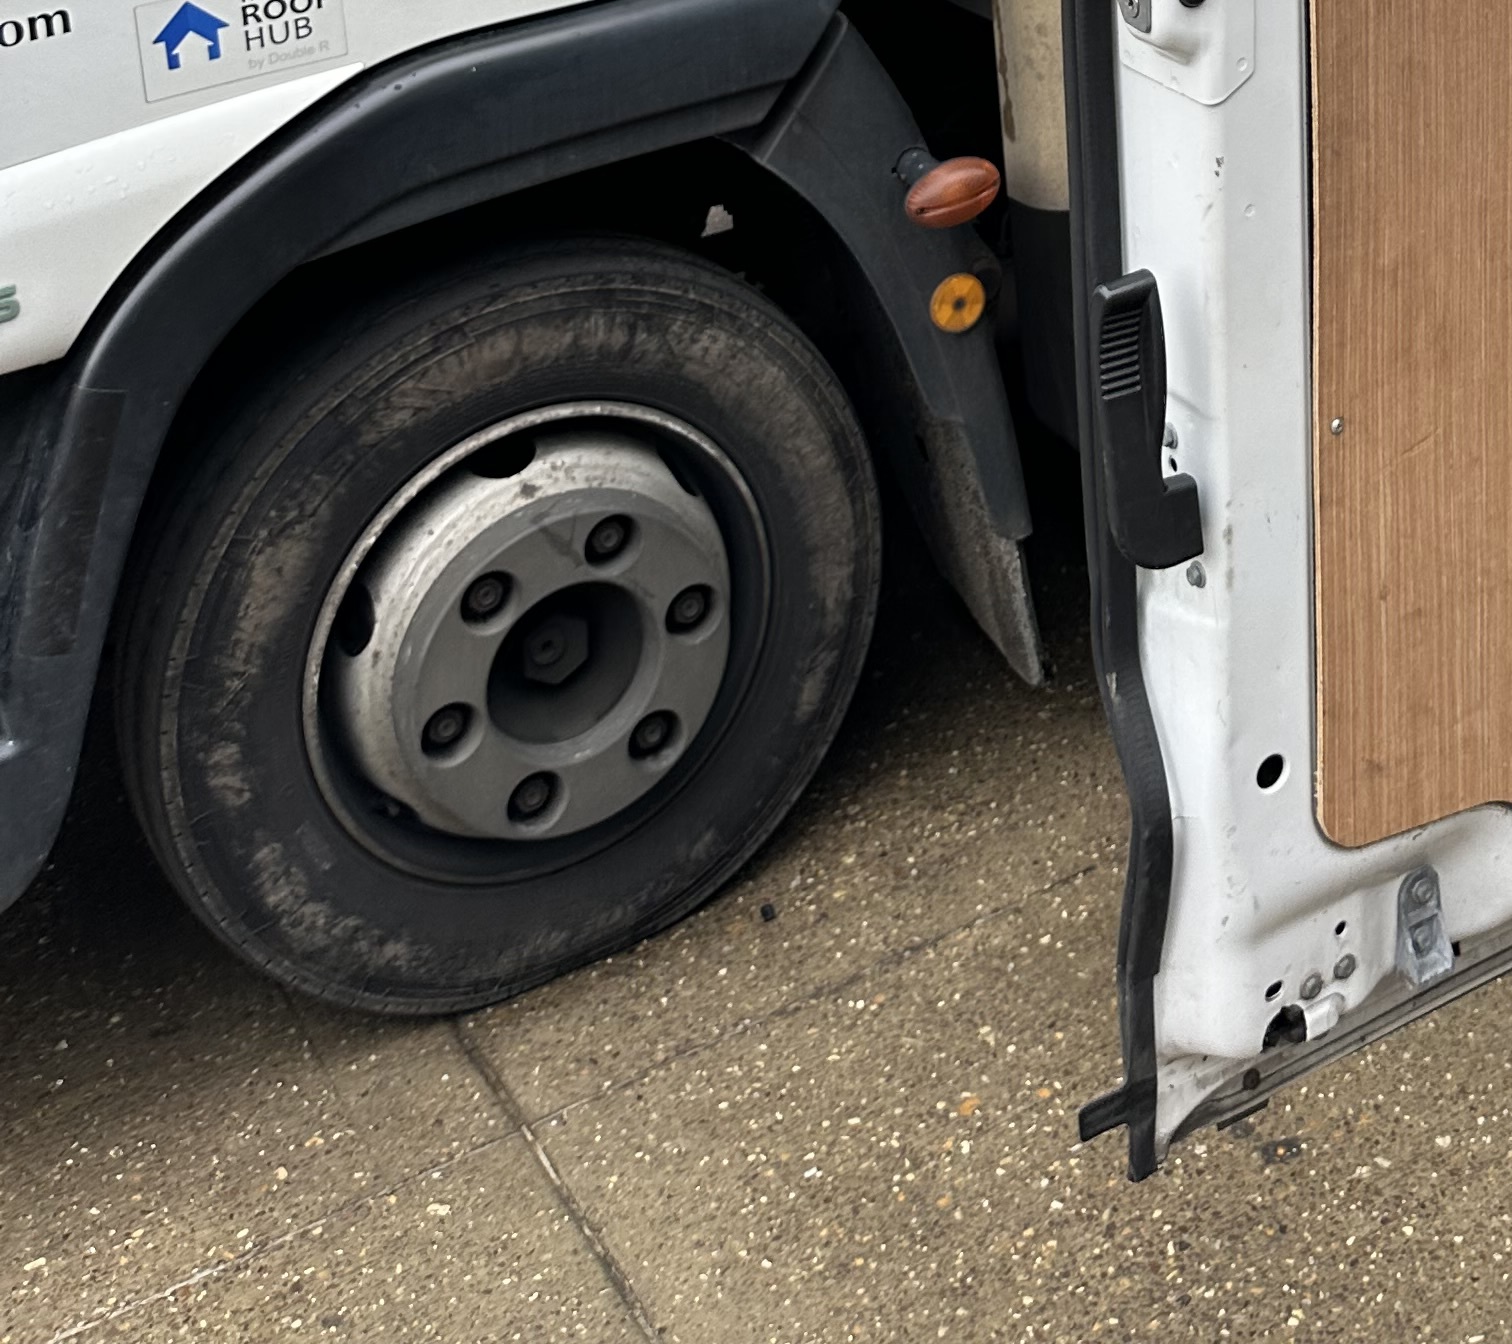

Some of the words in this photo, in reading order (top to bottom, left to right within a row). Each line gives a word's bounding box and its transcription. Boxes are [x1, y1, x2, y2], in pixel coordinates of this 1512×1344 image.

[245, 16, 314, 52] HUB
[248, 56, 265, 71] by
[268, 44, 316, 66] Double
[318, 39, 331, 53] R
